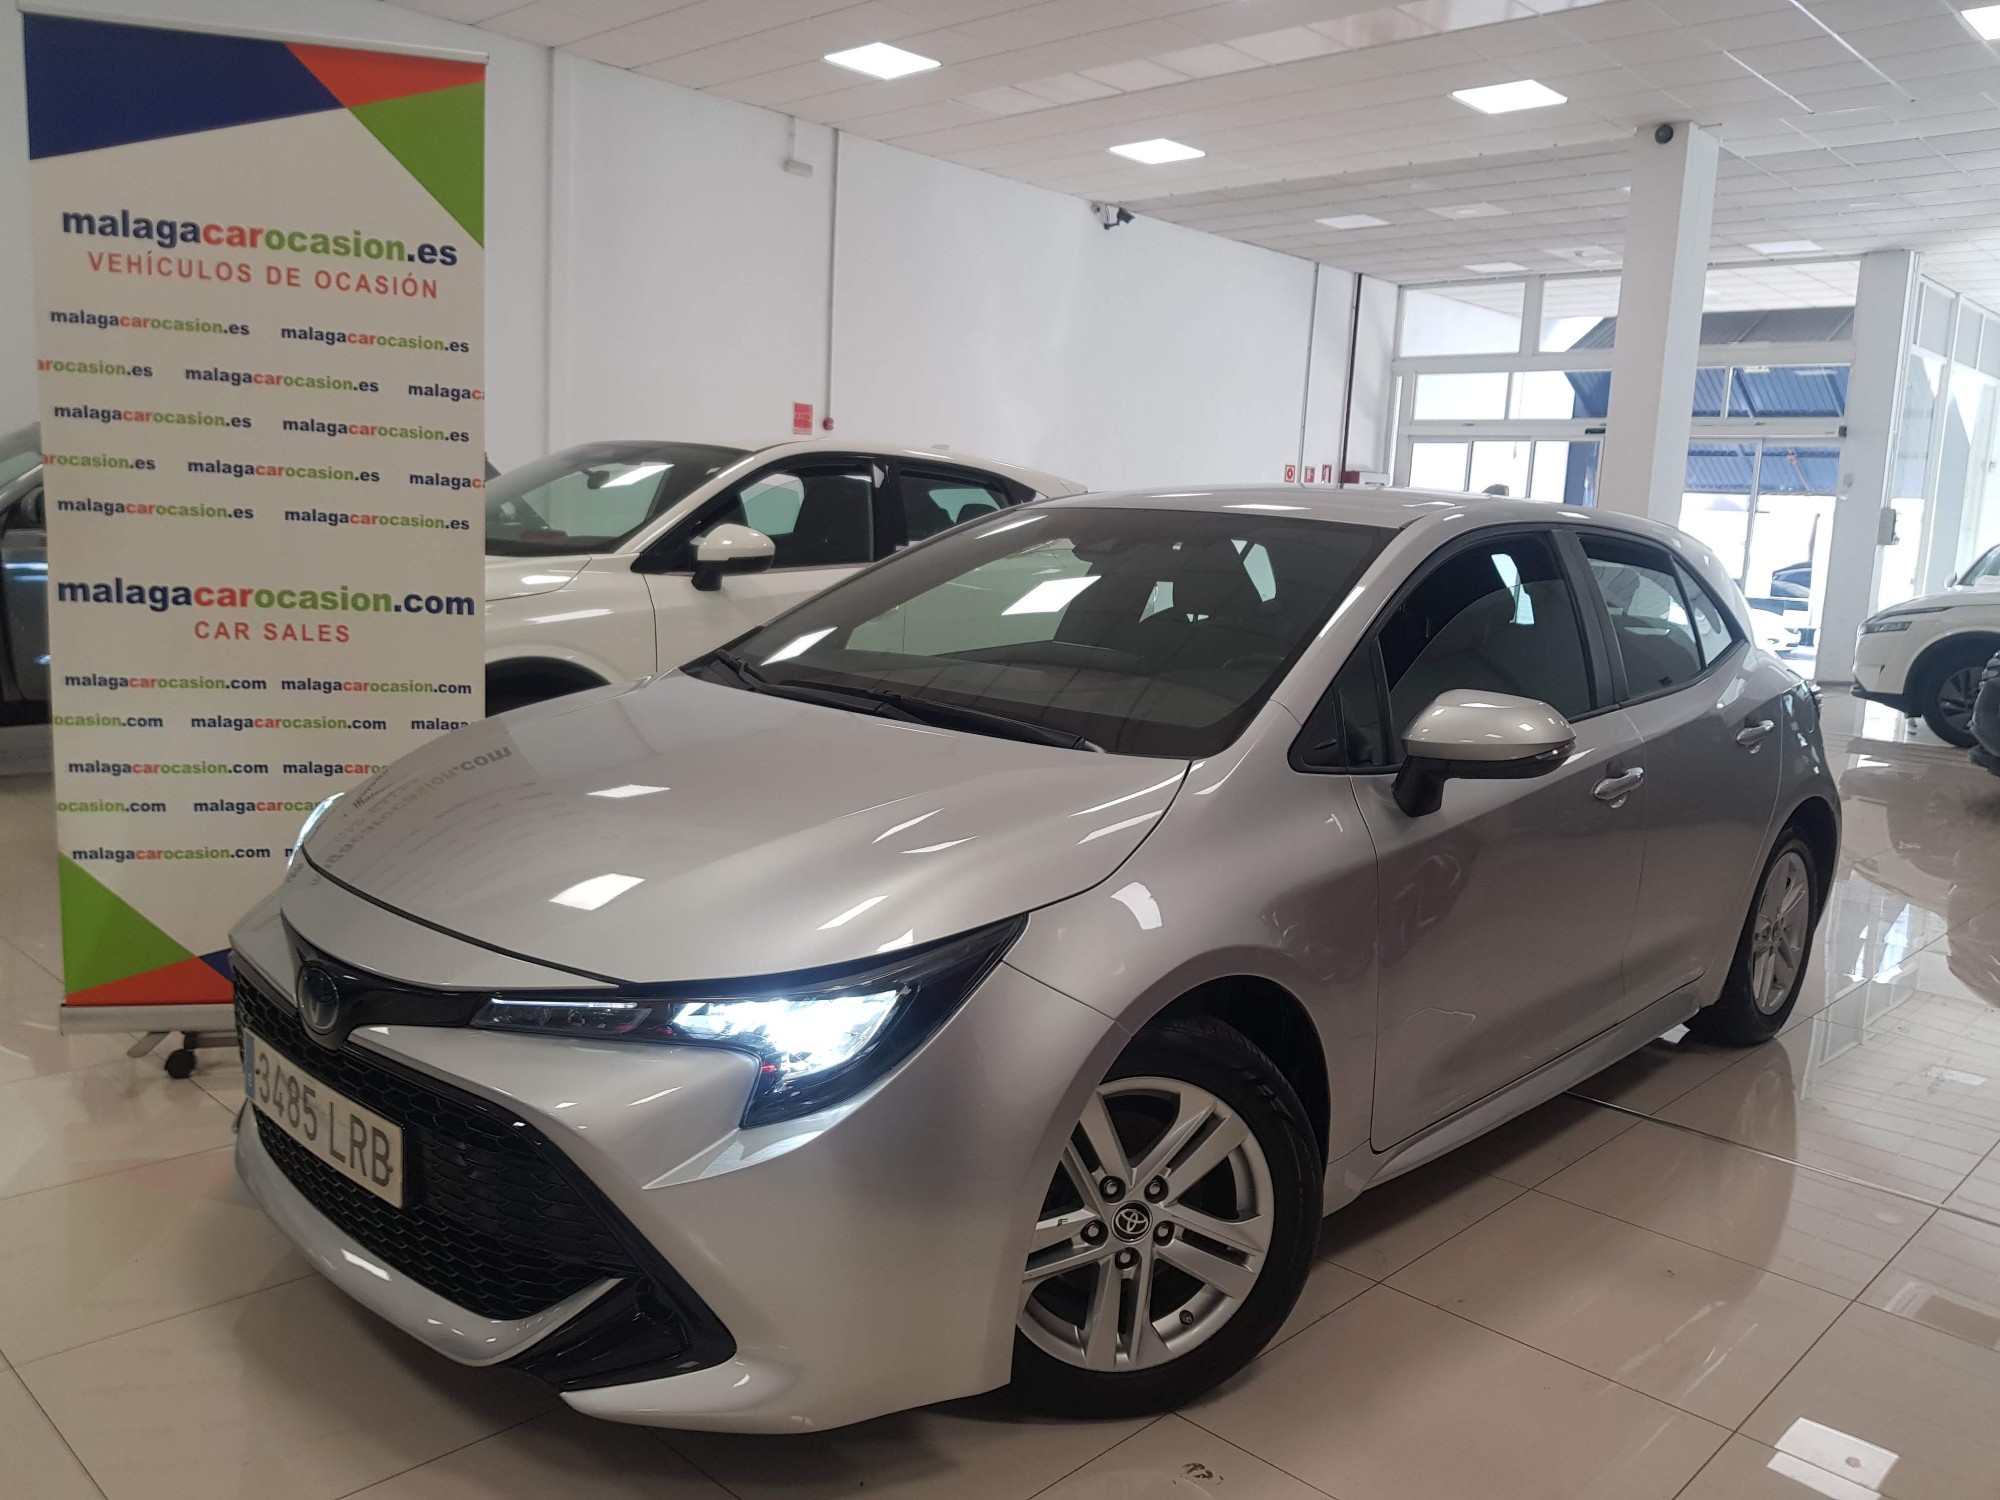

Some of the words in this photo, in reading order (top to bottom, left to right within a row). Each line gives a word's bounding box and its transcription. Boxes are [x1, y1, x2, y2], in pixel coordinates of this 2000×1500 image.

[61, 209, 459, 266] malagacarocasion.es
[87, 250, 253, 283] VEHÍCULOS
[265, 265, 302, 288] DE
[314, 269, 439, 299] OCASIÓN
[49, 308, 251, 337] malagacarocasion.es
[280, 325, 471, 354] malagacarocasion.es
[184, 366, 380, 394] malagacarocasion.es
[53, 403, 253, 429] malagacarocasion.es
[282, 417, 471, 443] malagacarocasion.es
[187, 458, 381, 484] malagacarocasion.es
[57, 497, 255, 520] malagacarocasion.es
[284, 507, 471, 531] malagacarocasion.es
[57, 578, 476, 616] malagacarocasion.com
[194, 620, 251, 641] CAR
[263, 622, 351, 643] SALES
[64, 672, 268, 692] malagacarocasion.com
[280, 676, 473, 696] malagacarocasion.com
[54, 712, 165, 728] ocasion.com
[190, 714, 387, 732] malagacarocasion.com
[410, 716, 474, 731] malaga
[68, 759, 269, 777] malagacarocasion.com
[57, 797, 167, 814] ocasion.com
[72, 845, 271, 864] malagacarocasion.com
[257, 1052, 319, 1142] 3485
[328, 1101, 391, 1188] LRB
